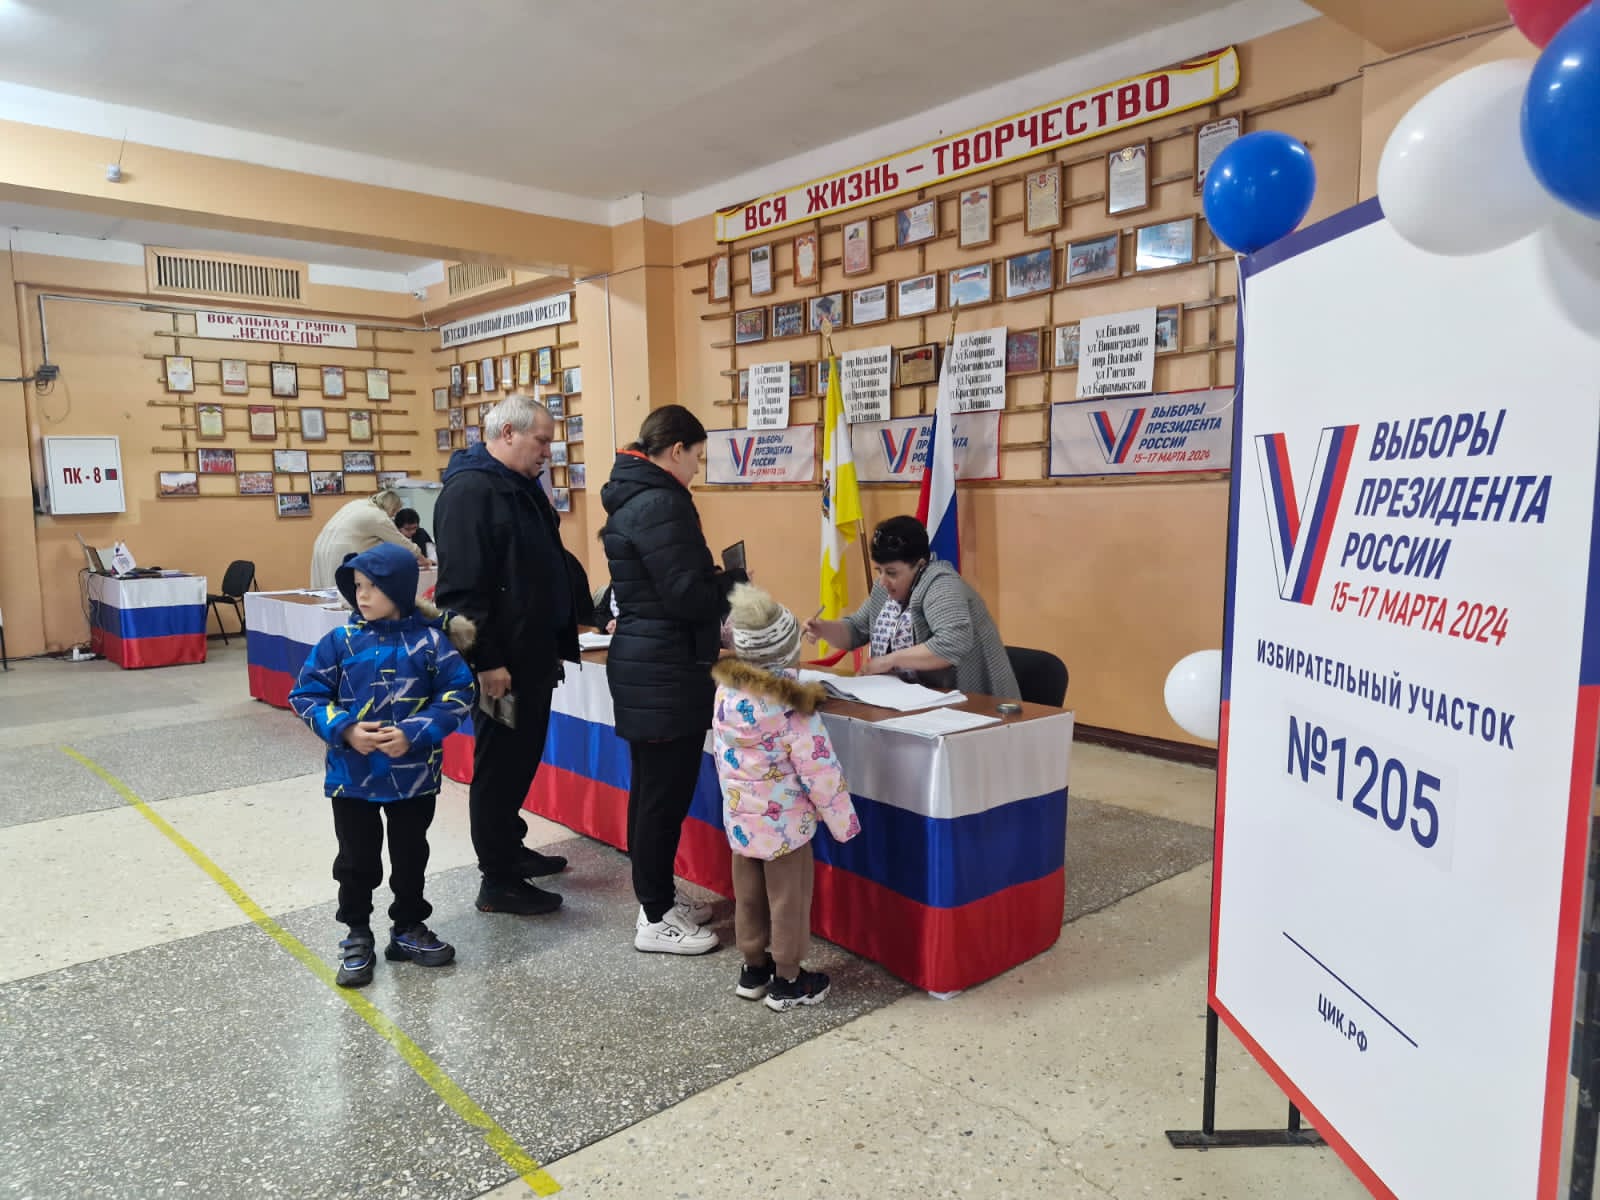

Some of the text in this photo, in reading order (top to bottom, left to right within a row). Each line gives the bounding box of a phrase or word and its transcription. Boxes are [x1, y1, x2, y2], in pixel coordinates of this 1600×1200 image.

[745, 196, 787, 231] ВСЯ
[806, 164, 899, 214] ЖИЗНЬ
[932, 74, 1170, 175] ТВОРЧЕСТВО
[535, 300, 567, 321] ОРКЕСТР
[207, 313, 347, 334] ВОКАЛЬНАЯ ГРУППА
[1151, 402, 1207, 418] ВЫБОРЫ
[1145, 417, 1222, 434] ПРЕЗИДЕНТА
[1369, 409, 1507, 461] ВЫБОРЫ
[757, 435, 784, 445] ВЫБОРЫ
[1138, 436, 1187, 450] РОССИИ
[754, 446, 793, 456] ПРЕЗИДЕНТА
[1158, 451, 1187, 462] МАРТА
[1187, 449, 1211, 461] 2024
[751, 457, 777, 467] РОССИИ
[63, 467, 82, 484] ПК
[93, 467, 102, 484] 8
[1354, 475, 1552, 527] ПРЕЗИДЕНТА
[1340, 532, 1452, 579] РОССИИ
[1378, 588, 1445, 634] МАРТА
[1448, 601, 1508, 646] 2024
[1257, 639, 1515, 750] ИЗБИРАТЕЛЬНЫЙ УЧАСТОК
[1317, 993, 1368, 1053] ЦИК.РФ
